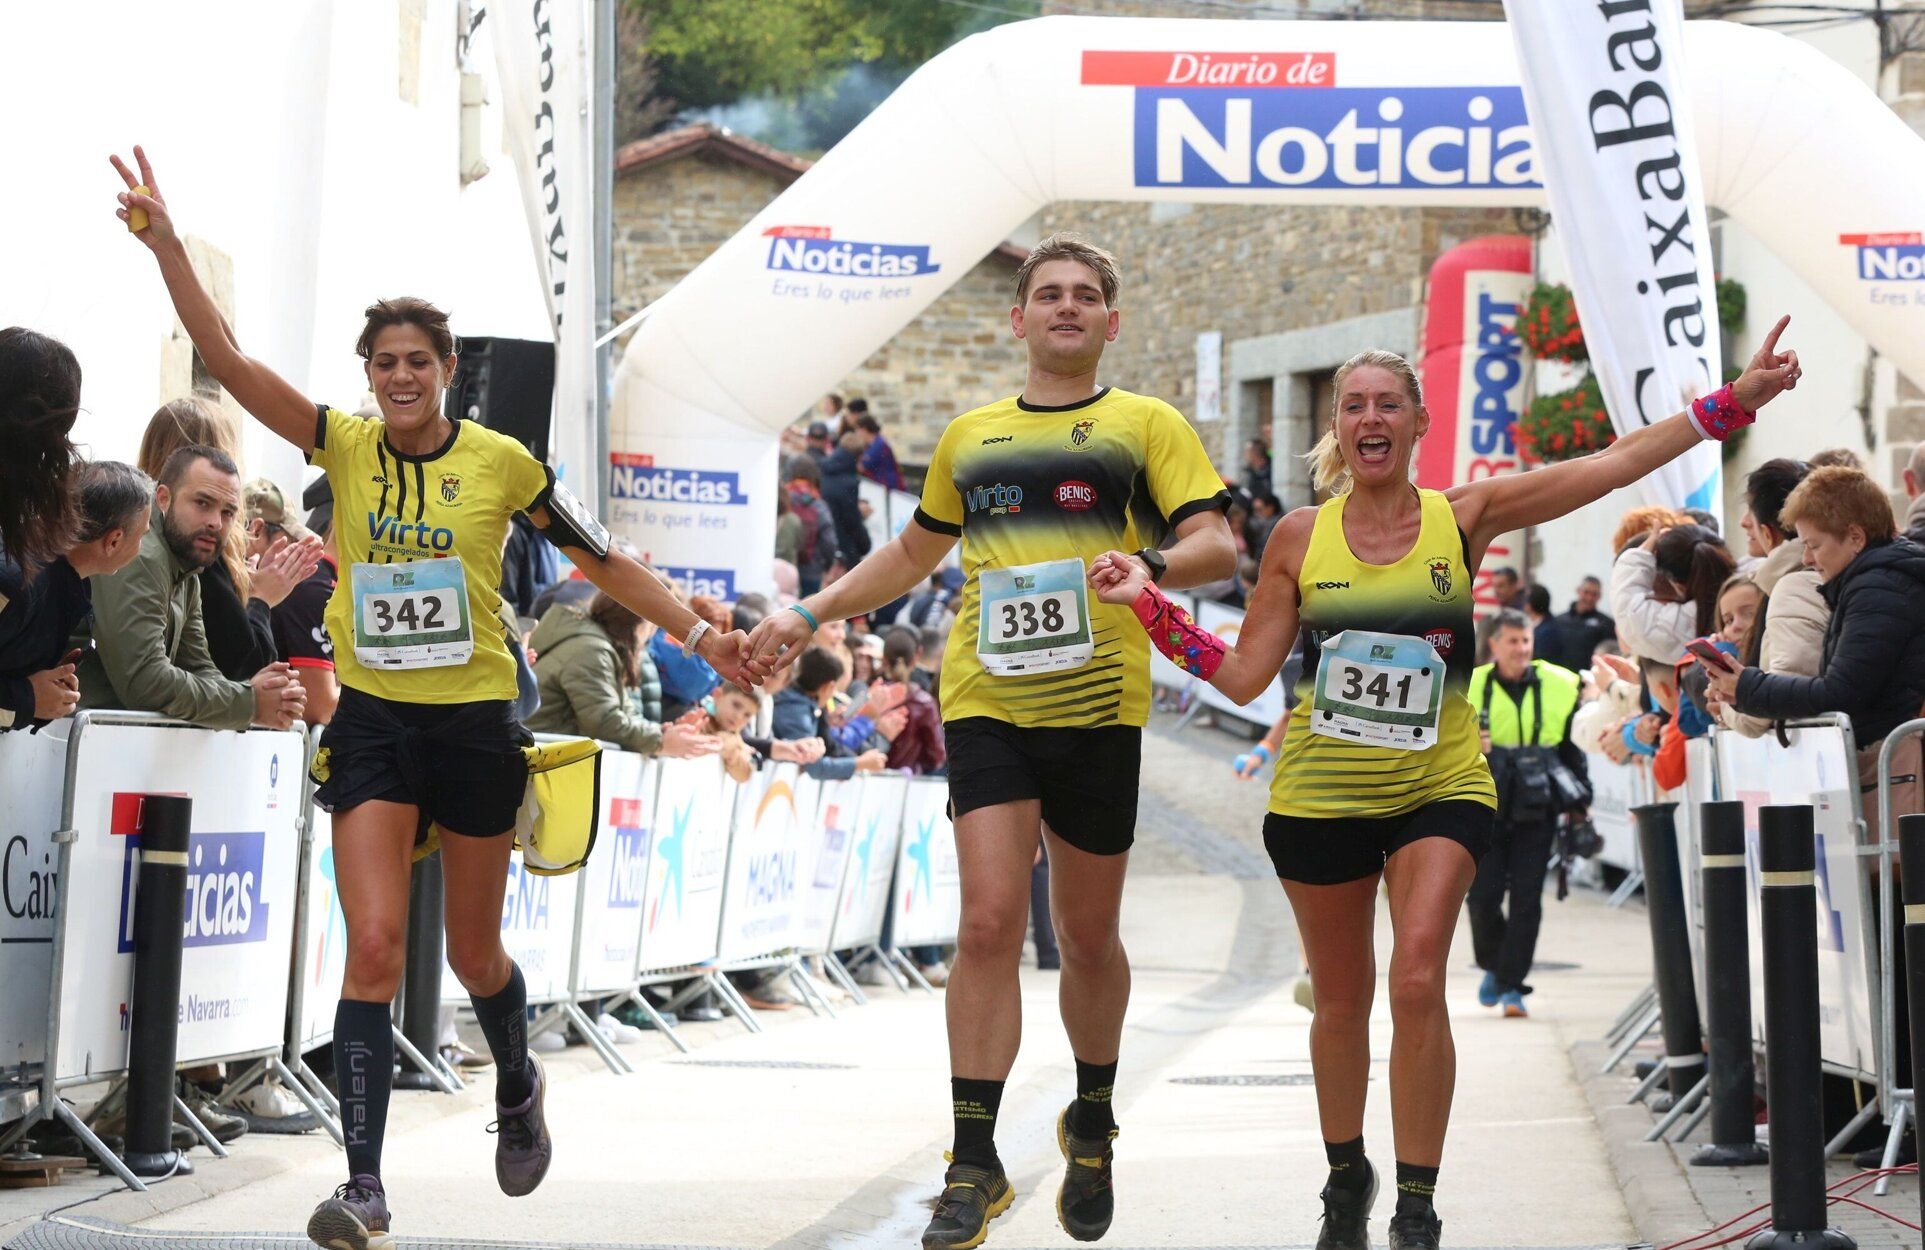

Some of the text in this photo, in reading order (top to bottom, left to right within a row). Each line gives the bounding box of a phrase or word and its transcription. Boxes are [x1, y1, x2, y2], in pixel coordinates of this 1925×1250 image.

[1166, 54, 1327, 84] Diario de
[772, 238, 918, 276] Noticias
[612, 467, 731, 503] Noticias
[967, 483, 1023, 513] Virto
[1060, 485, 1091, 502] BENIS
[368, 511, 453, 551] Virto
[371, 543, 430, 558] ultracongelados
[373, 596, 445, 633] 342
[1002, 598, 1064, 639] 338
[1342, 667, 1412, 708] 341
[345, 1041, 372, 1144] kalenji
